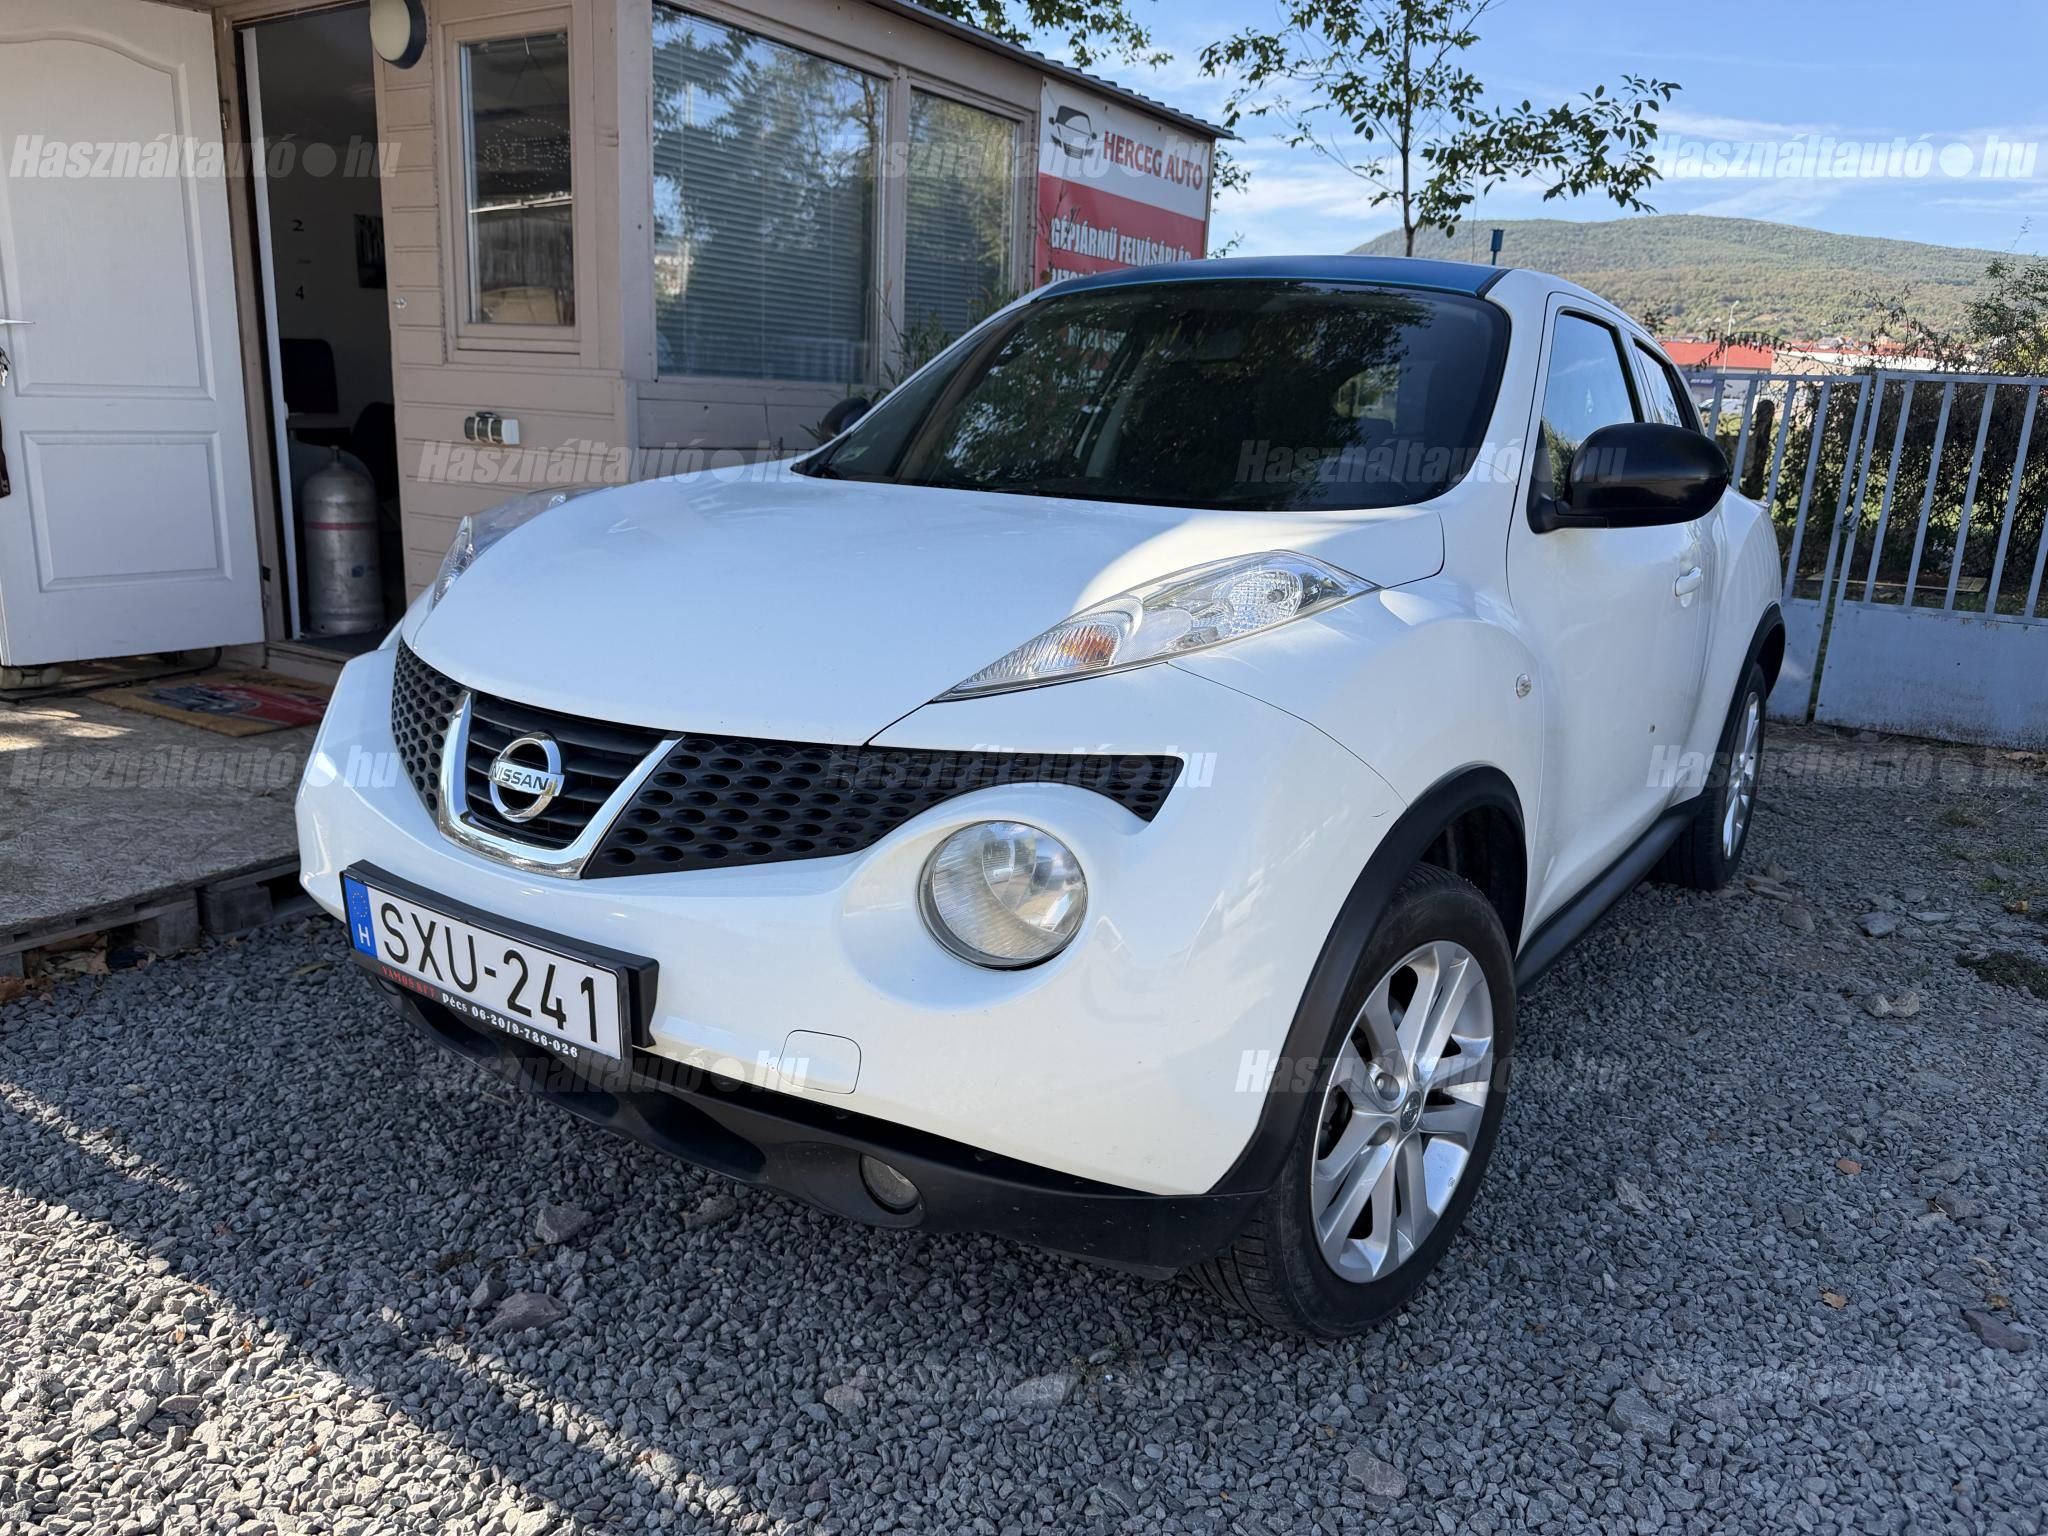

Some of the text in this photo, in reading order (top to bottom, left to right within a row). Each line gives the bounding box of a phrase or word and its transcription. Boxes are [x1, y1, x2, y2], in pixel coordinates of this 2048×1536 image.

[1103, 131, 1203, 190] HERCEG AUTO
[488, 763, 549, 791] NISSAN
[358, 922, 370, 947] H
[380, 902, 598, 1043] SXU-241
